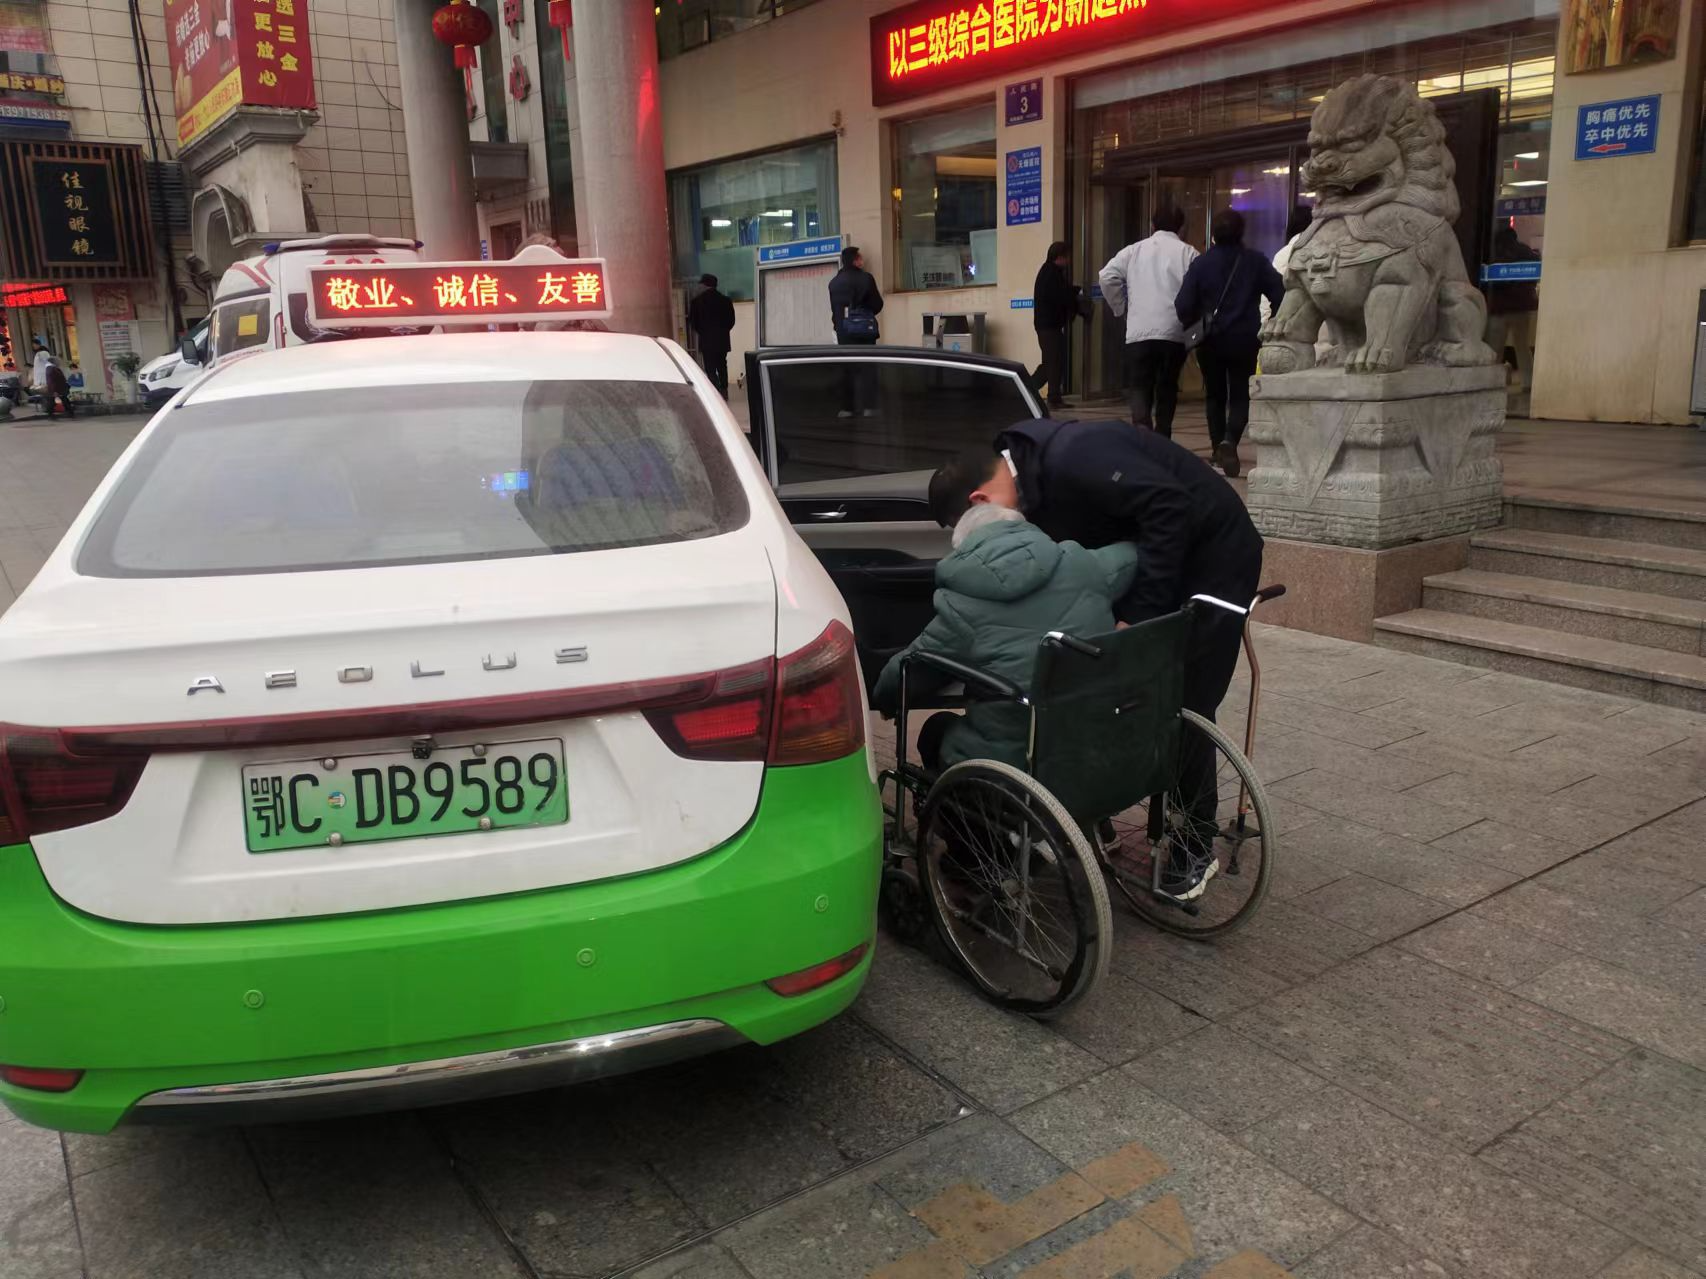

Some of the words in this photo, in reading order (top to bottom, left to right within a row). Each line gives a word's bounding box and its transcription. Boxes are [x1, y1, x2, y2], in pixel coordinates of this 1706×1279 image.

[253, 0, 277, 87] 更放心
[888, 0, 1147, 79] 以三级综合医院为新
[1020, 96, 1029, 114] 3
[1585, 103, 1651, 126] 胸痛优先
[1584, 123, 1649, 144] 卒中优先
[60, 170, 95, 256] 佳视眼镜
[186, 645, 588, 696] AEOLUS
